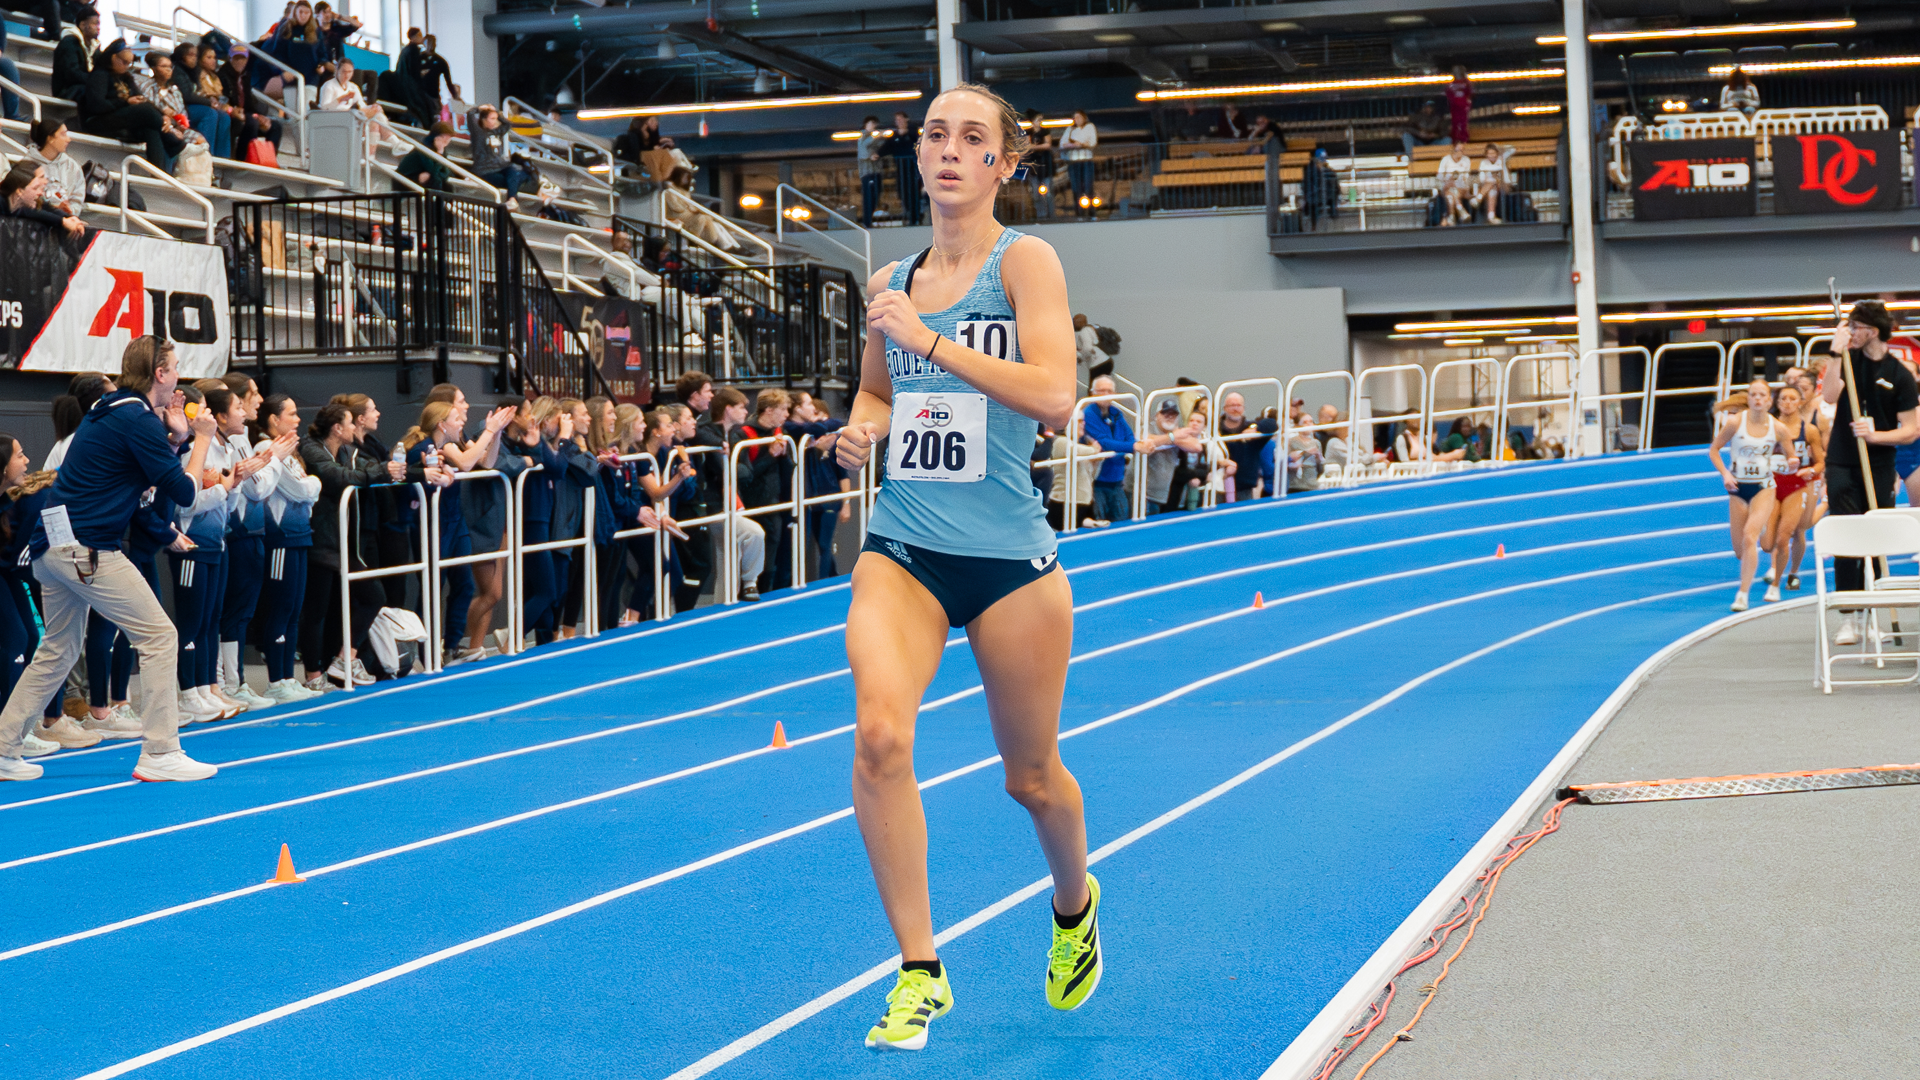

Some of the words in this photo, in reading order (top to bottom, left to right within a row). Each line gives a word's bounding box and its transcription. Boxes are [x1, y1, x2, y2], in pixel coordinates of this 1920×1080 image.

[1639, 159, 1751, 191] A10
[1795, 134, 1878, 206] DC
[88, 266, 218, 345] A10
[960, 322, 1008, 360] 10
[914, 408, 950, 420] A10
[900, 429, 966, 472] 206
